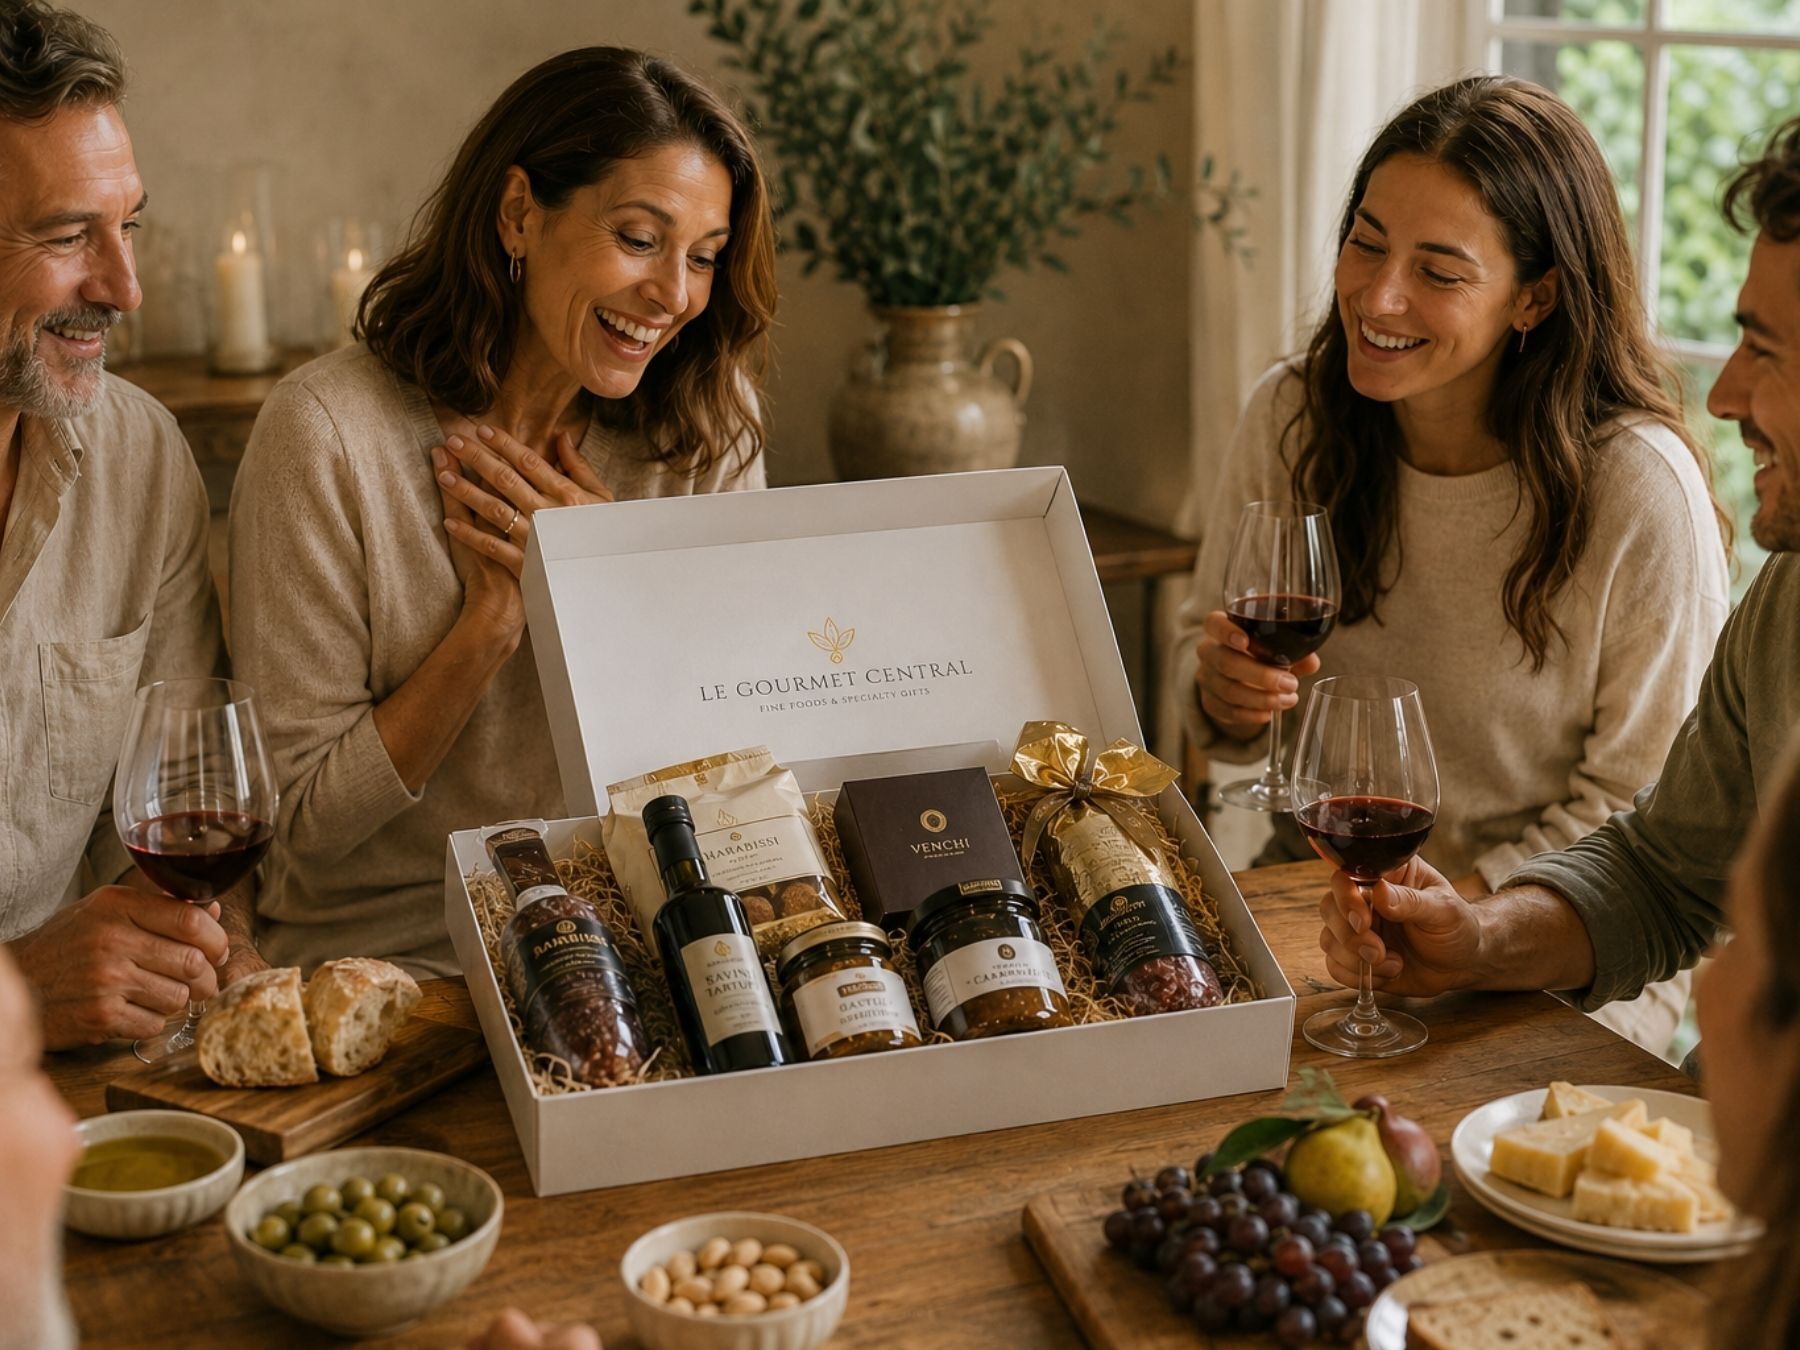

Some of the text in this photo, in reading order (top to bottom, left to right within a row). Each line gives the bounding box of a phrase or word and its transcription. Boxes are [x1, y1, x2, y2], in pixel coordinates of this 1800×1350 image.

[700, 660, 973, 702] LE GOURMET CENTRAL
[760, 687, 930, 713] FINE FOODS & SPECIALTY GIFTS
[910, 837, 970, 854] VENCHI
